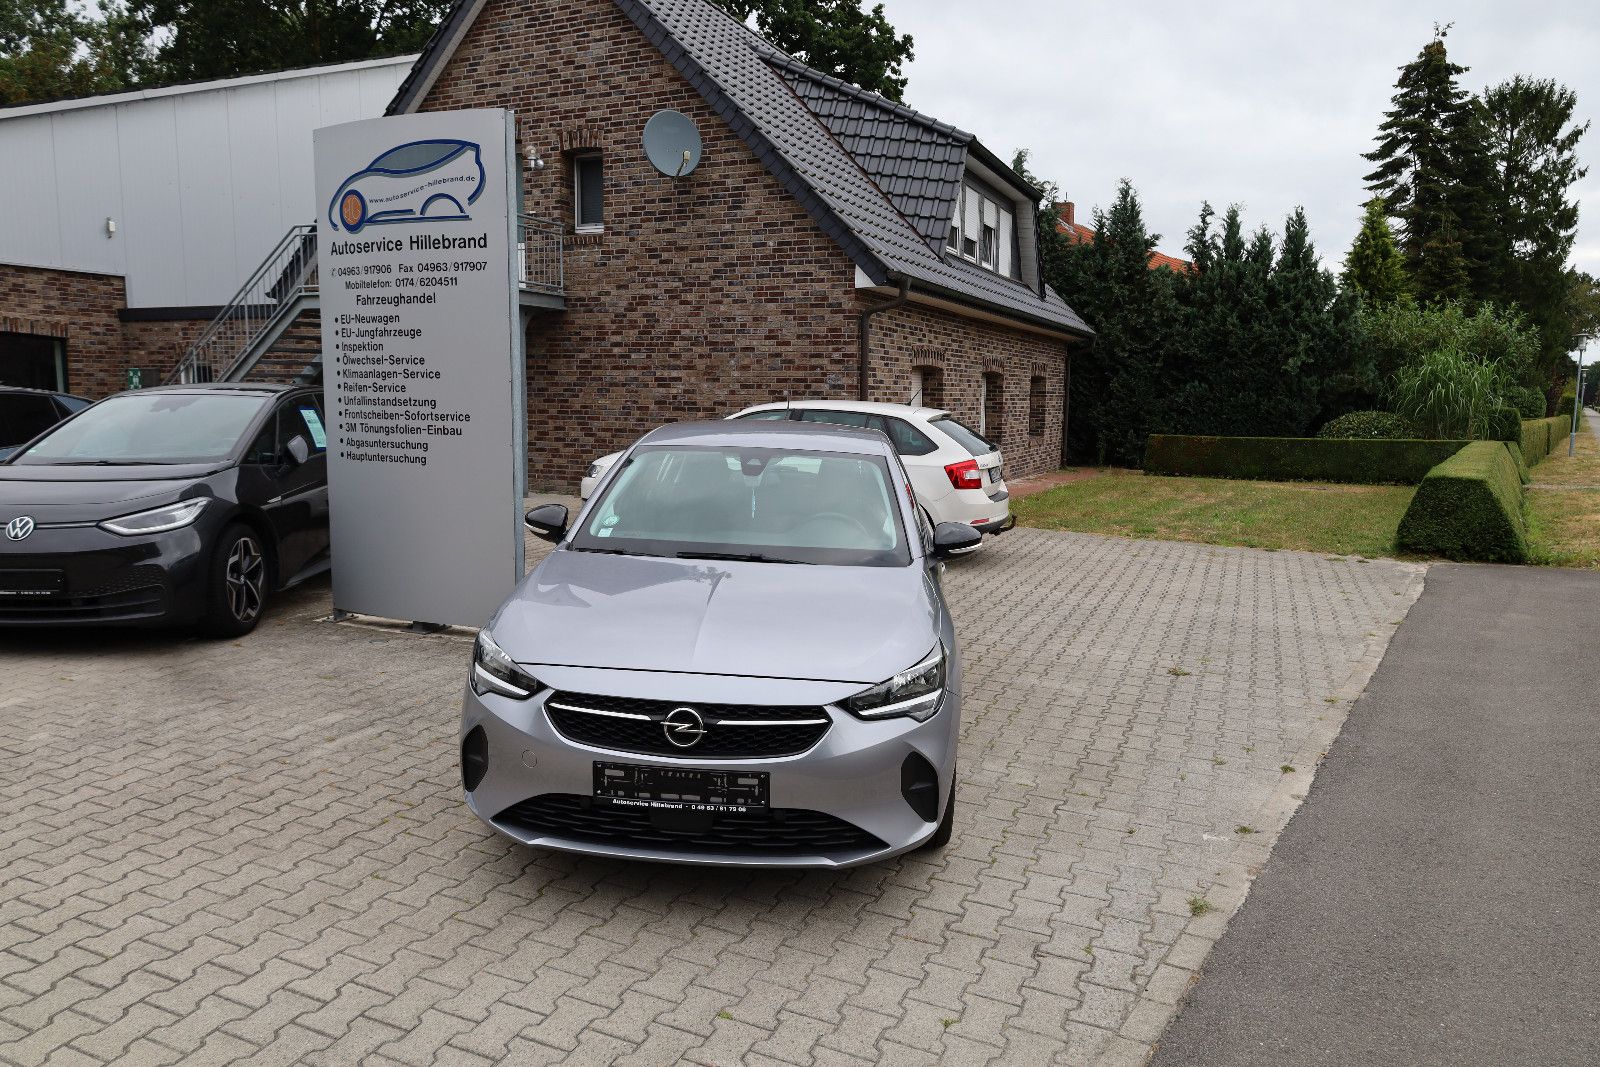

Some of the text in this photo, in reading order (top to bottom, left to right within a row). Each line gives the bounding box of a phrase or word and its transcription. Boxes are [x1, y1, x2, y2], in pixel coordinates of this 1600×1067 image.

[368, 176, 476, 204] www.autoservice-hillebrand.de
[330, 233, 488, 256] Autoservice Hillebrand
[337, 261, 488, 277] 04963/917906 Fax 04963/917907
[345, 276, 458, 290] Mobiltelefon: 0174/6204511
[356, 293, 436, 307] Fahrzeughandel
[340, 313, 400, 325] EU-Neuwagen
[341, 327, 422, 340] EU-Jungfahrzeuge
[341, 341, 384, 353] Inspektion
[342, 353, 425, 366] Ölwechsel-Service
[342, 368, 441, 381] Klimaanlagen-Service
[343, 382, 407, 393] Reifen-Service
[343, 396, 437, 409] Unfallinstandsetzung
[344, 409, 471, 422] Frontscheiben-Sofortservice
[345, 422, 463, 436] 3M Tönungsfolien-Einbau
[346, 437, 429, 452] Abgasuntersuchung
[346, 452, 427, 466] Hauptuntersuchung
[612, 798, 649, 807] Autoservice
[650, 801, 683, 809] Hillebrand
